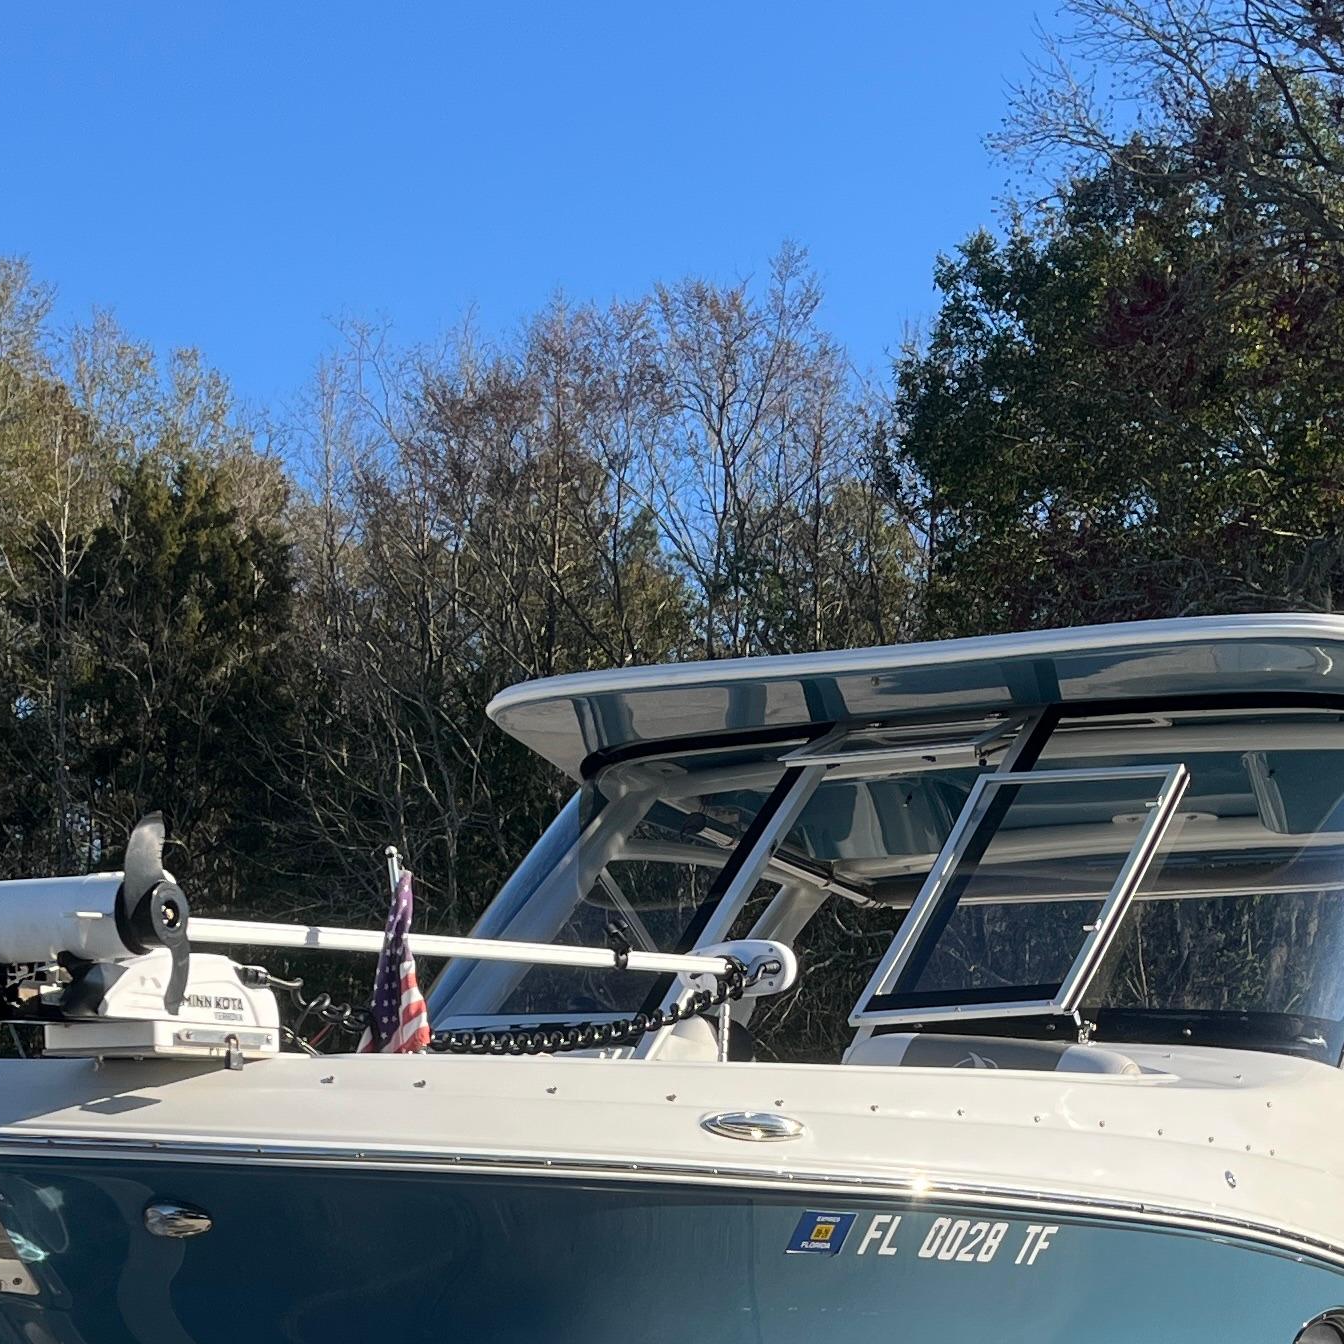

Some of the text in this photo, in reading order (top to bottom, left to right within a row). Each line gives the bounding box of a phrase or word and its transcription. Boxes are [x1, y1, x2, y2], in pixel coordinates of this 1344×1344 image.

[184, 994, 244, 1011] MINN KOTA
[857, 1214, 1059, 1265] FL 0028 TF
